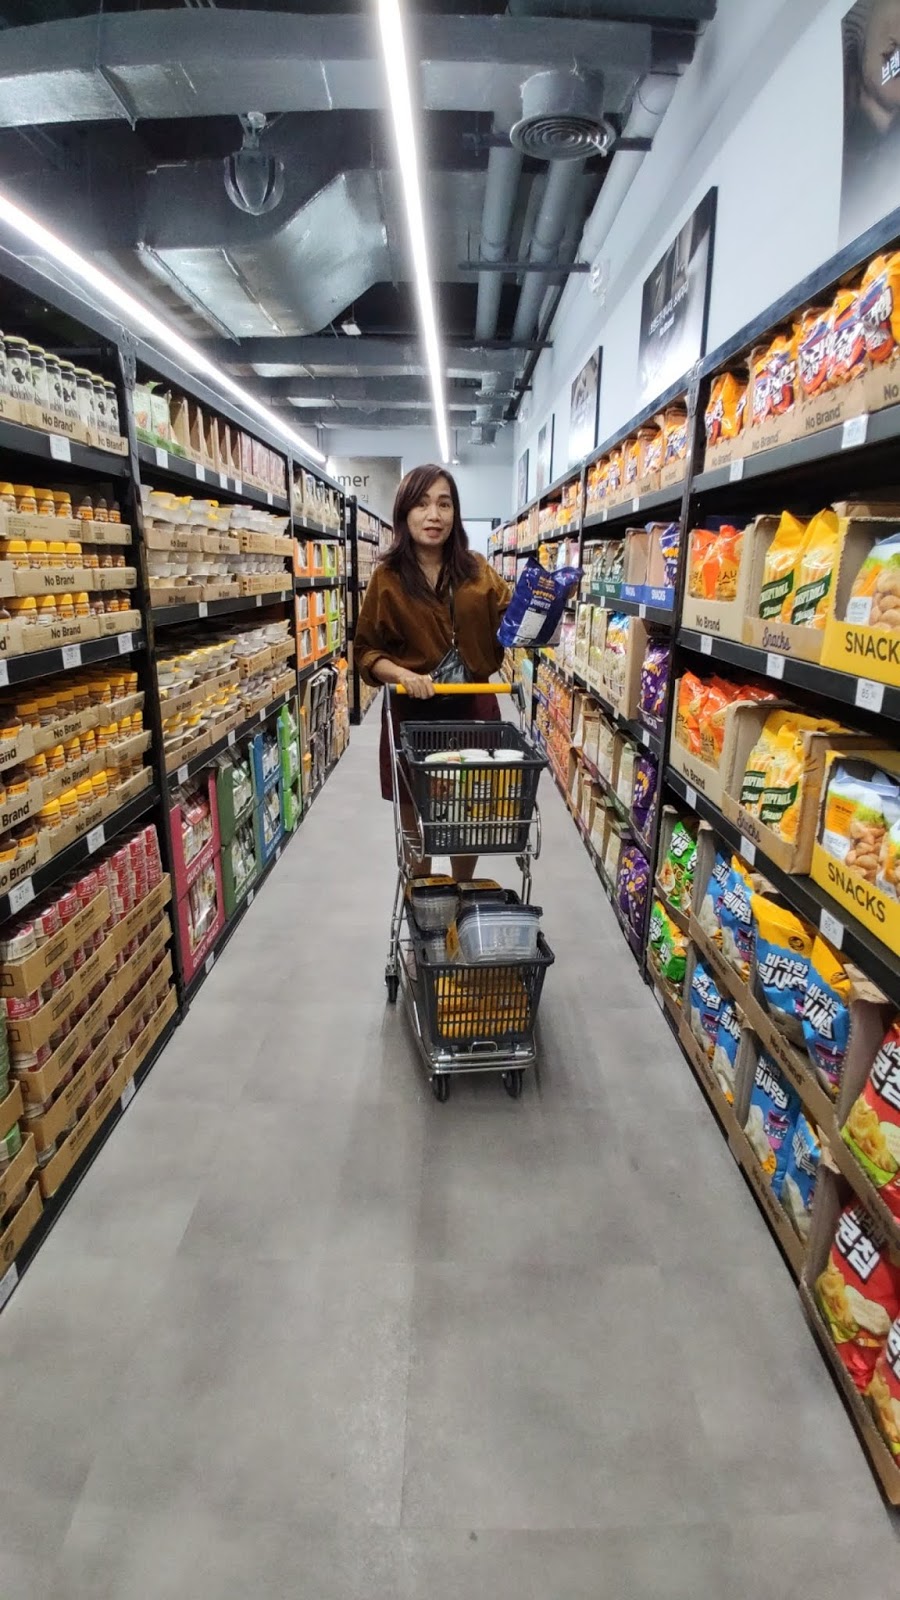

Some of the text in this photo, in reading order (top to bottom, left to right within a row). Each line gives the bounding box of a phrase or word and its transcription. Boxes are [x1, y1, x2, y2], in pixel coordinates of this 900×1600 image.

[884, 384, 899, 399] No
[42, 412, 73, 433] No Brand
[805, 404, 840, 428] No Brand
[106, 438, 123, 452] Brand
[333, 475, 370, 488] mer
[44, 574, 75, 586] No Brand
[50, 625, 82, 640] No Brand
[696, 614, 720, 632] No Brand
[762, 627, 791, 651] Snacks
[845, 631, 900, 665] SNACK
[53, 721, 82, 739] No Brand
[61, 765, 90, 787] No Brand
[682, 763, 706, 790] No Brand
[2, 801, 30, 827] Brand
[75, 808, 102, 834] No Brand
[9, 855, 37, 880] Brand
[827, 862, 886, 923] SNACKS
[766, 952, 809, 978] 바삭한
